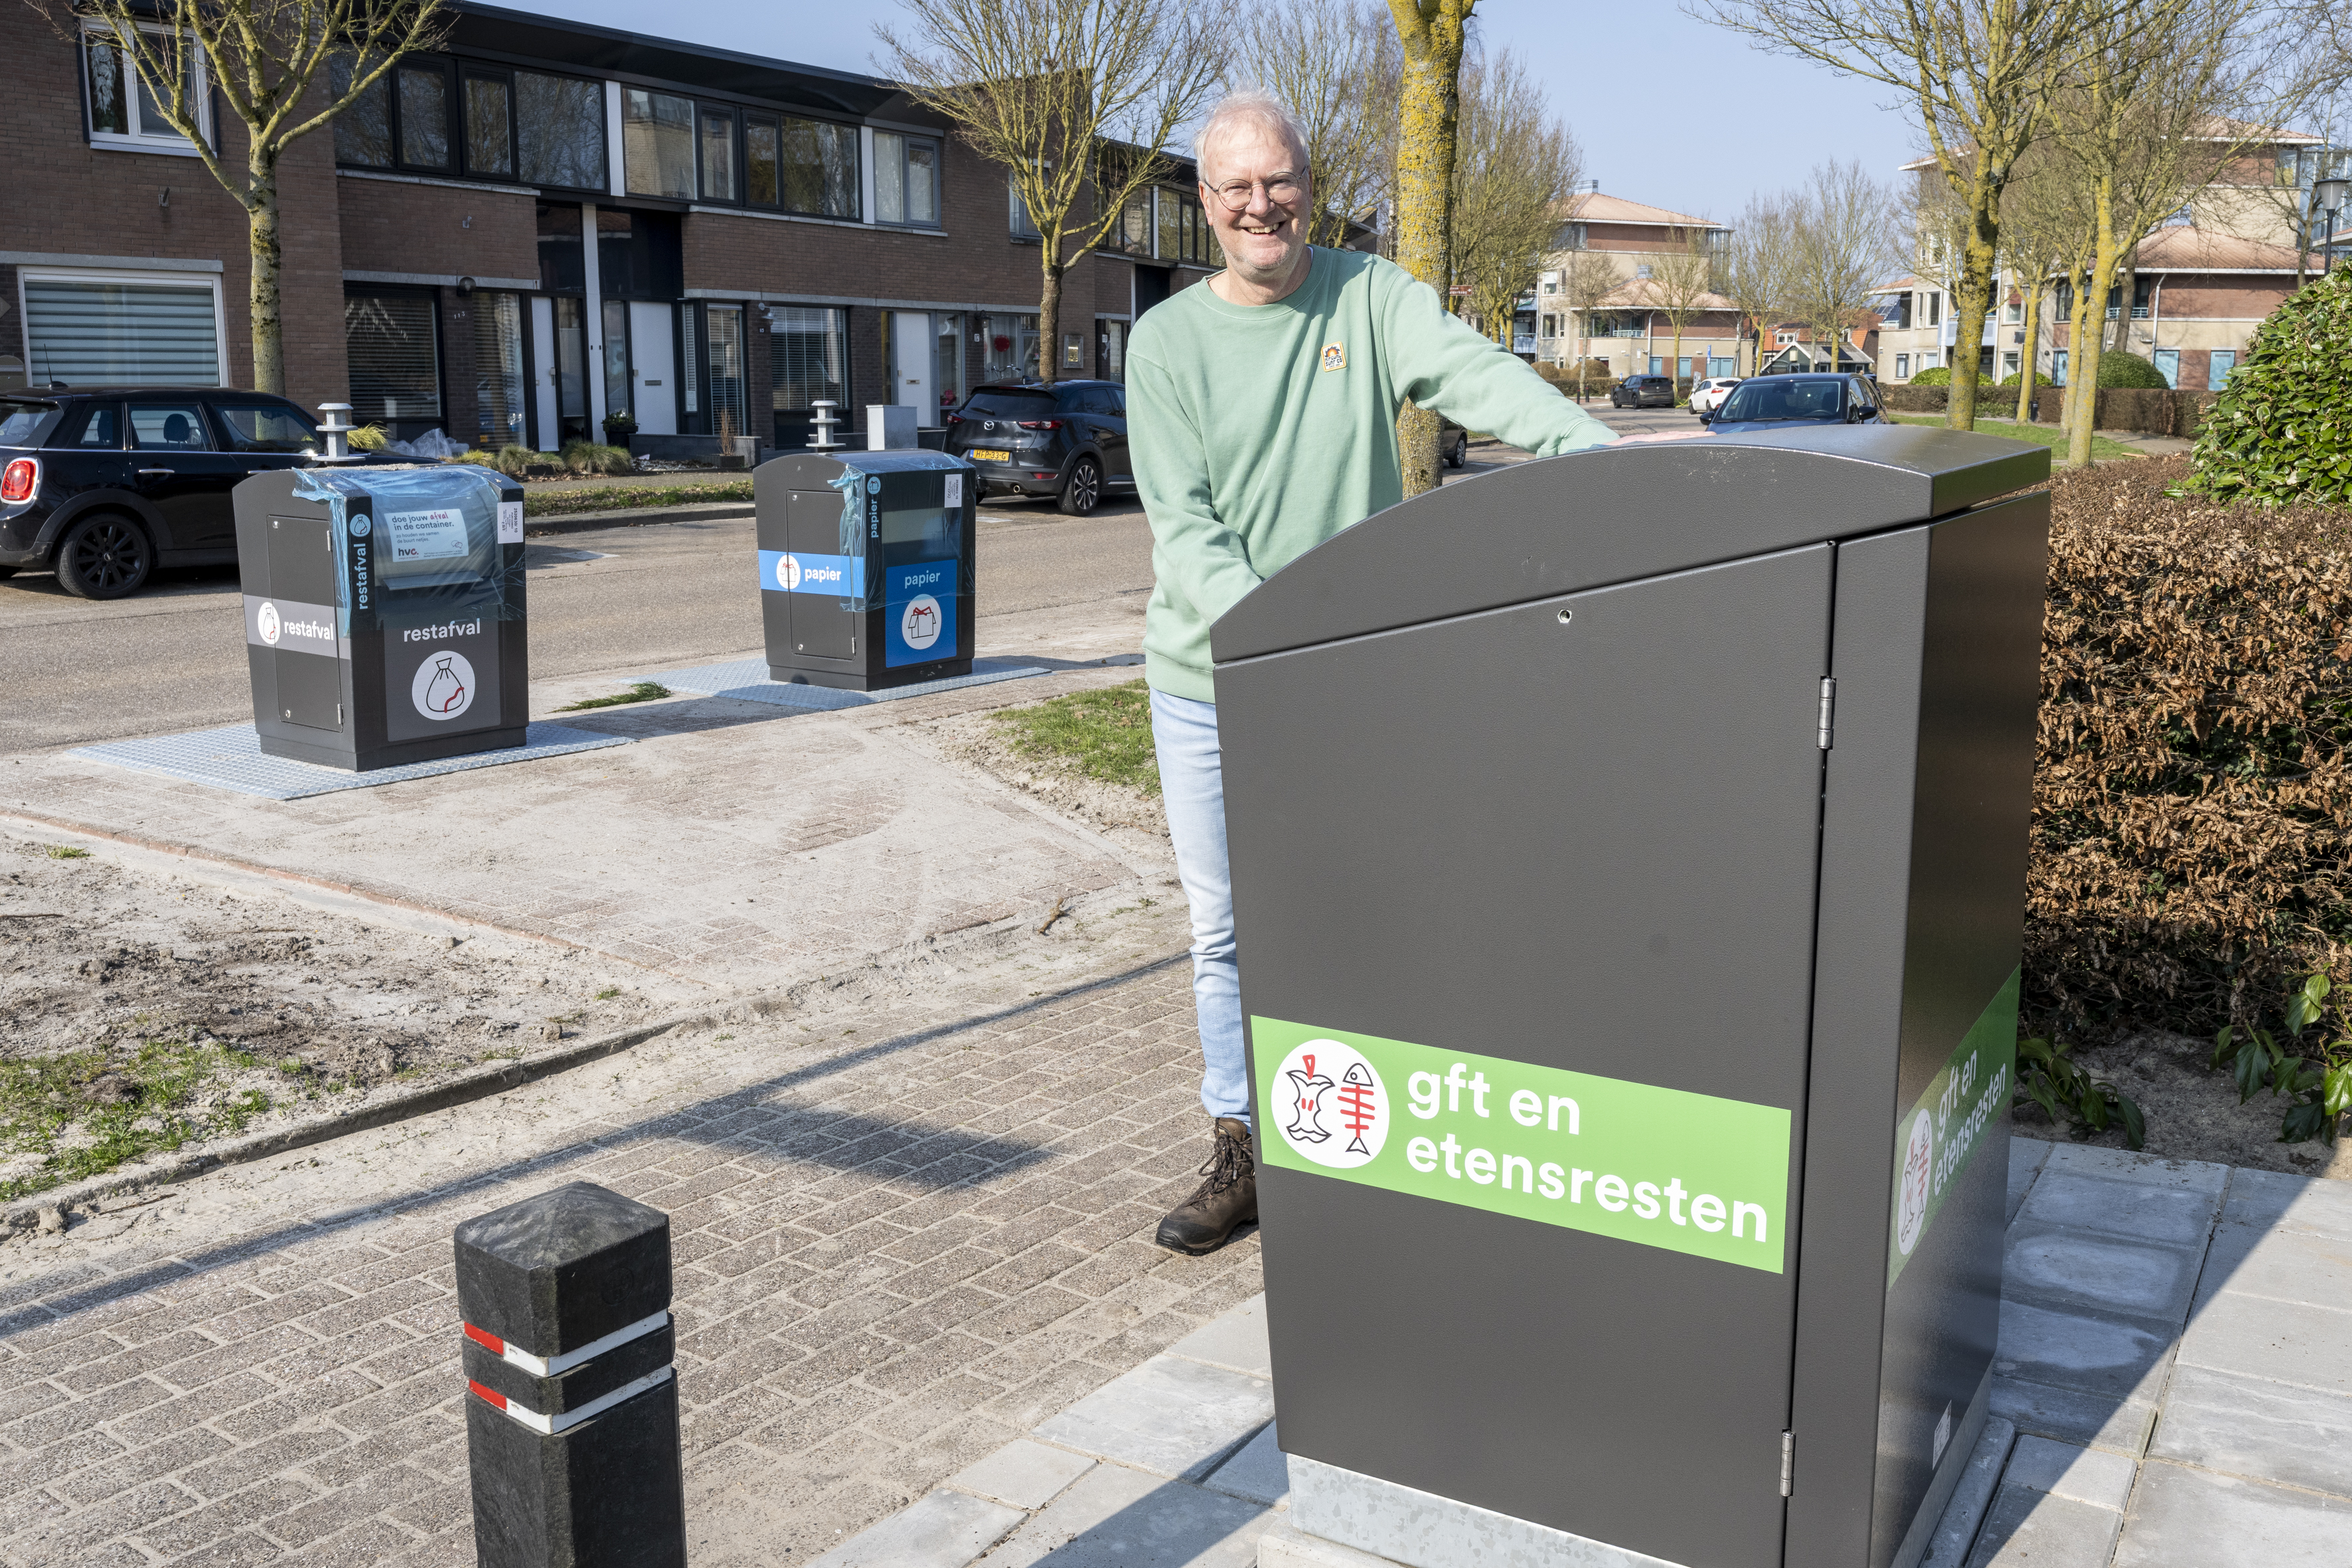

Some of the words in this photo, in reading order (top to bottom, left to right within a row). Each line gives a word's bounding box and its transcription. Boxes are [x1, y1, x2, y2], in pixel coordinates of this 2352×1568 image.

[976, 451, 1006, 460] HFP-33-G
[408, 514, 428, 524] jouw
[430, 511, 449, 520] afval
[416, 520, 455, 529] container.
[869, 499, 879, 538] papier
[353, 543, 368, 609] restafval
[805, 566, 841, 583] papier
[905, 570, 941, 589] papier
[284, 620, 334, 641] restafval
[404, 617, 481, 643] restafval
[1407, 1062, 1491, 1120] gft
[1509, 1089, 1580, 1136] en
[1937, 1065, 1958, 1142] gft
[1962, 1049, 1977, 1097] en
[1934, 1063, 2006, 1196] etensresten
[1407, 1133, 1768, 1243] etensresten
